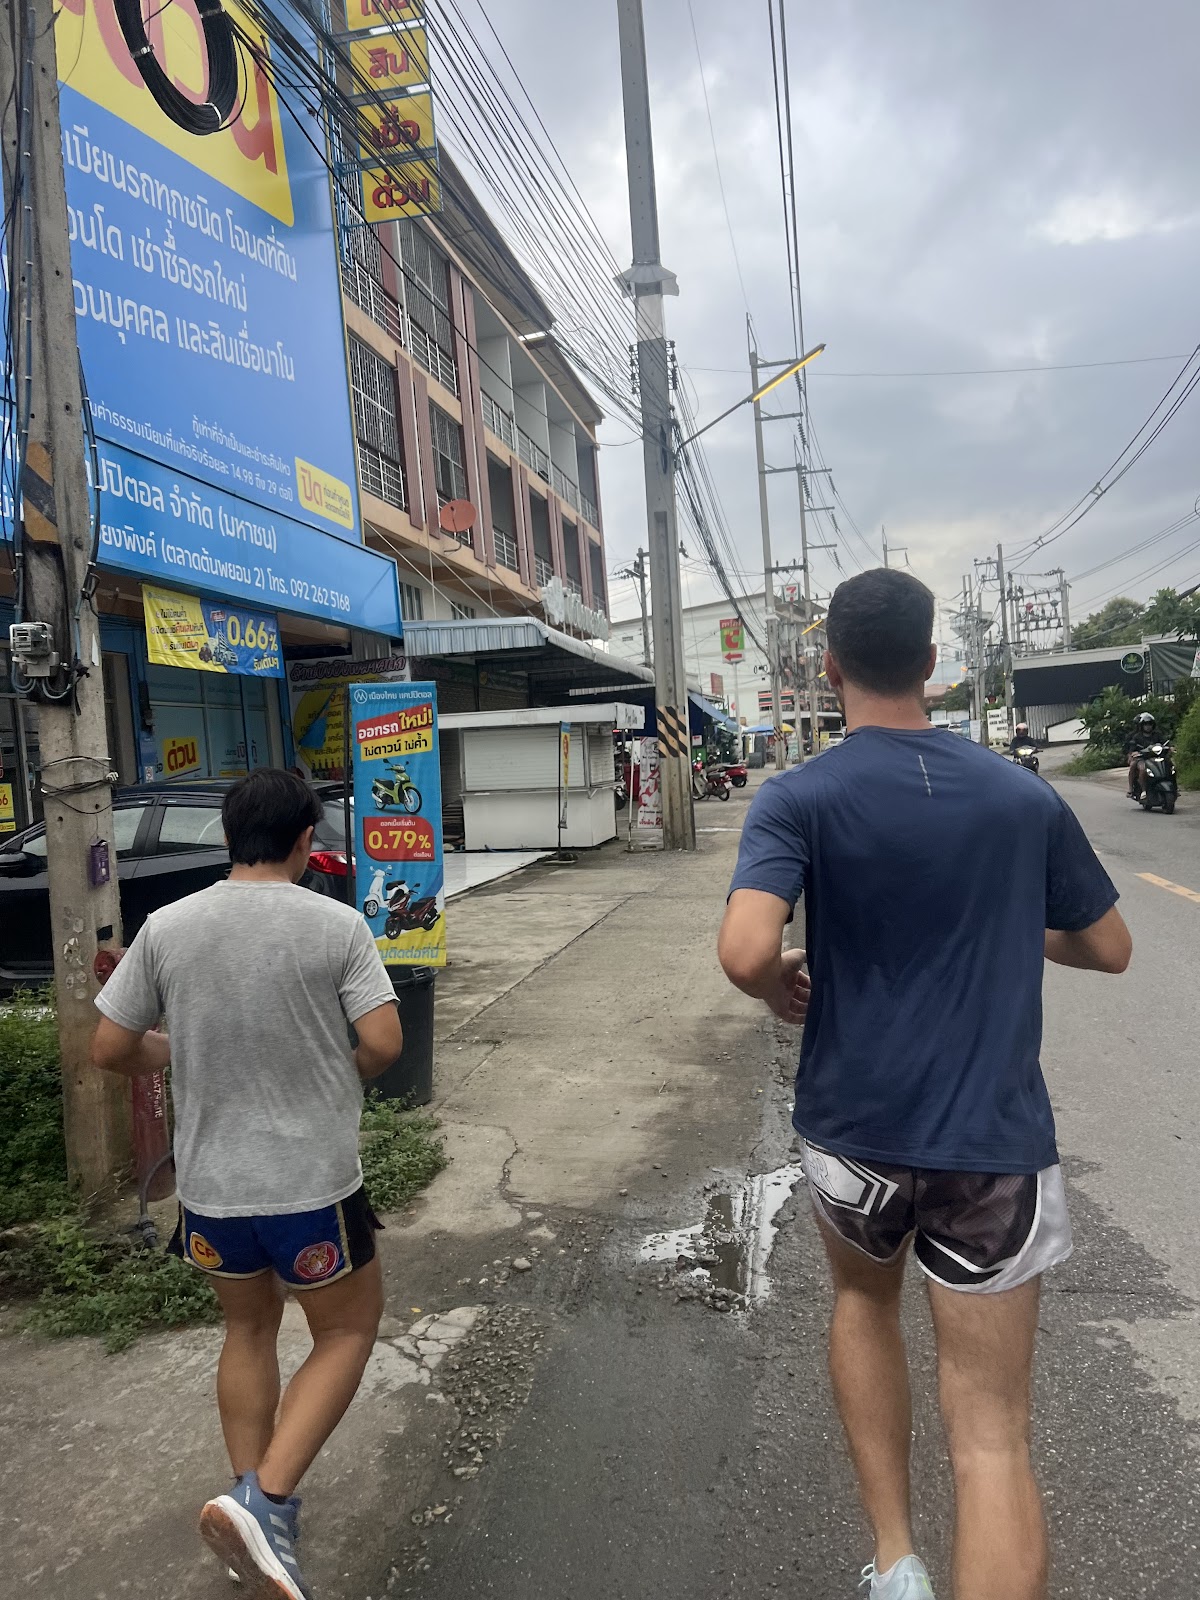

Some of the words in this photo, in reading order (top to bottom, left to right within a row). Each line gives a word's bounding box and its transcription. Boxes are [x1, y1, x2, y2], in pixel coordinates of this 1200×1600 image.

[369, 47, 410, 79] สิน
[61, 124, 224, 244] เบียนรถทุกชนิด
[225, 207, 298, 283] โฉนดที่ดิน
[372, 175, 430, 209] ด่วน
[131, 227, 248, 313] เช่าซื้อรถใหม่
[176, 320, 295, 382] และสินเชื่อนาโน
[231, 463, 254, 486] 14.98
[267, 479, 277, 495] 29
[300, 467, 323, 507] ปิด
[169, 484, 214, 530] จำกัด
[219, 505, 277, 554] (มหาชน)
[161, 537, 251, 585] (ตลาดต้นพยอม
[254, 567, 265, 591] 2)
[267, 568, 289, 595] โทร.
[290, 578, 310, 601] 092
[312, 584, 330, 607] 262
[331, 590, 351, 612] 5168
[227, 615, 269, 650] 0.66
[269, 633, 279, 652] %
[368, 690, 398, 700] เมืองไทย
[399, 690, 433, 700] แคปปิตอล
[358, 722, 399, 740] ออกรถ
[398, 706, 434, 731] ใหม่!
[167, 740, 197, 772] ด่วน
[364, 739, 402, 757] ไม่ดาวน์
[404, 733, 428, 750] ไม่ค้ำ
[368, 830, 417, 850] 0.79
[418, 834, 432, 849] %
[194, 1240, 216, 1259] CP
